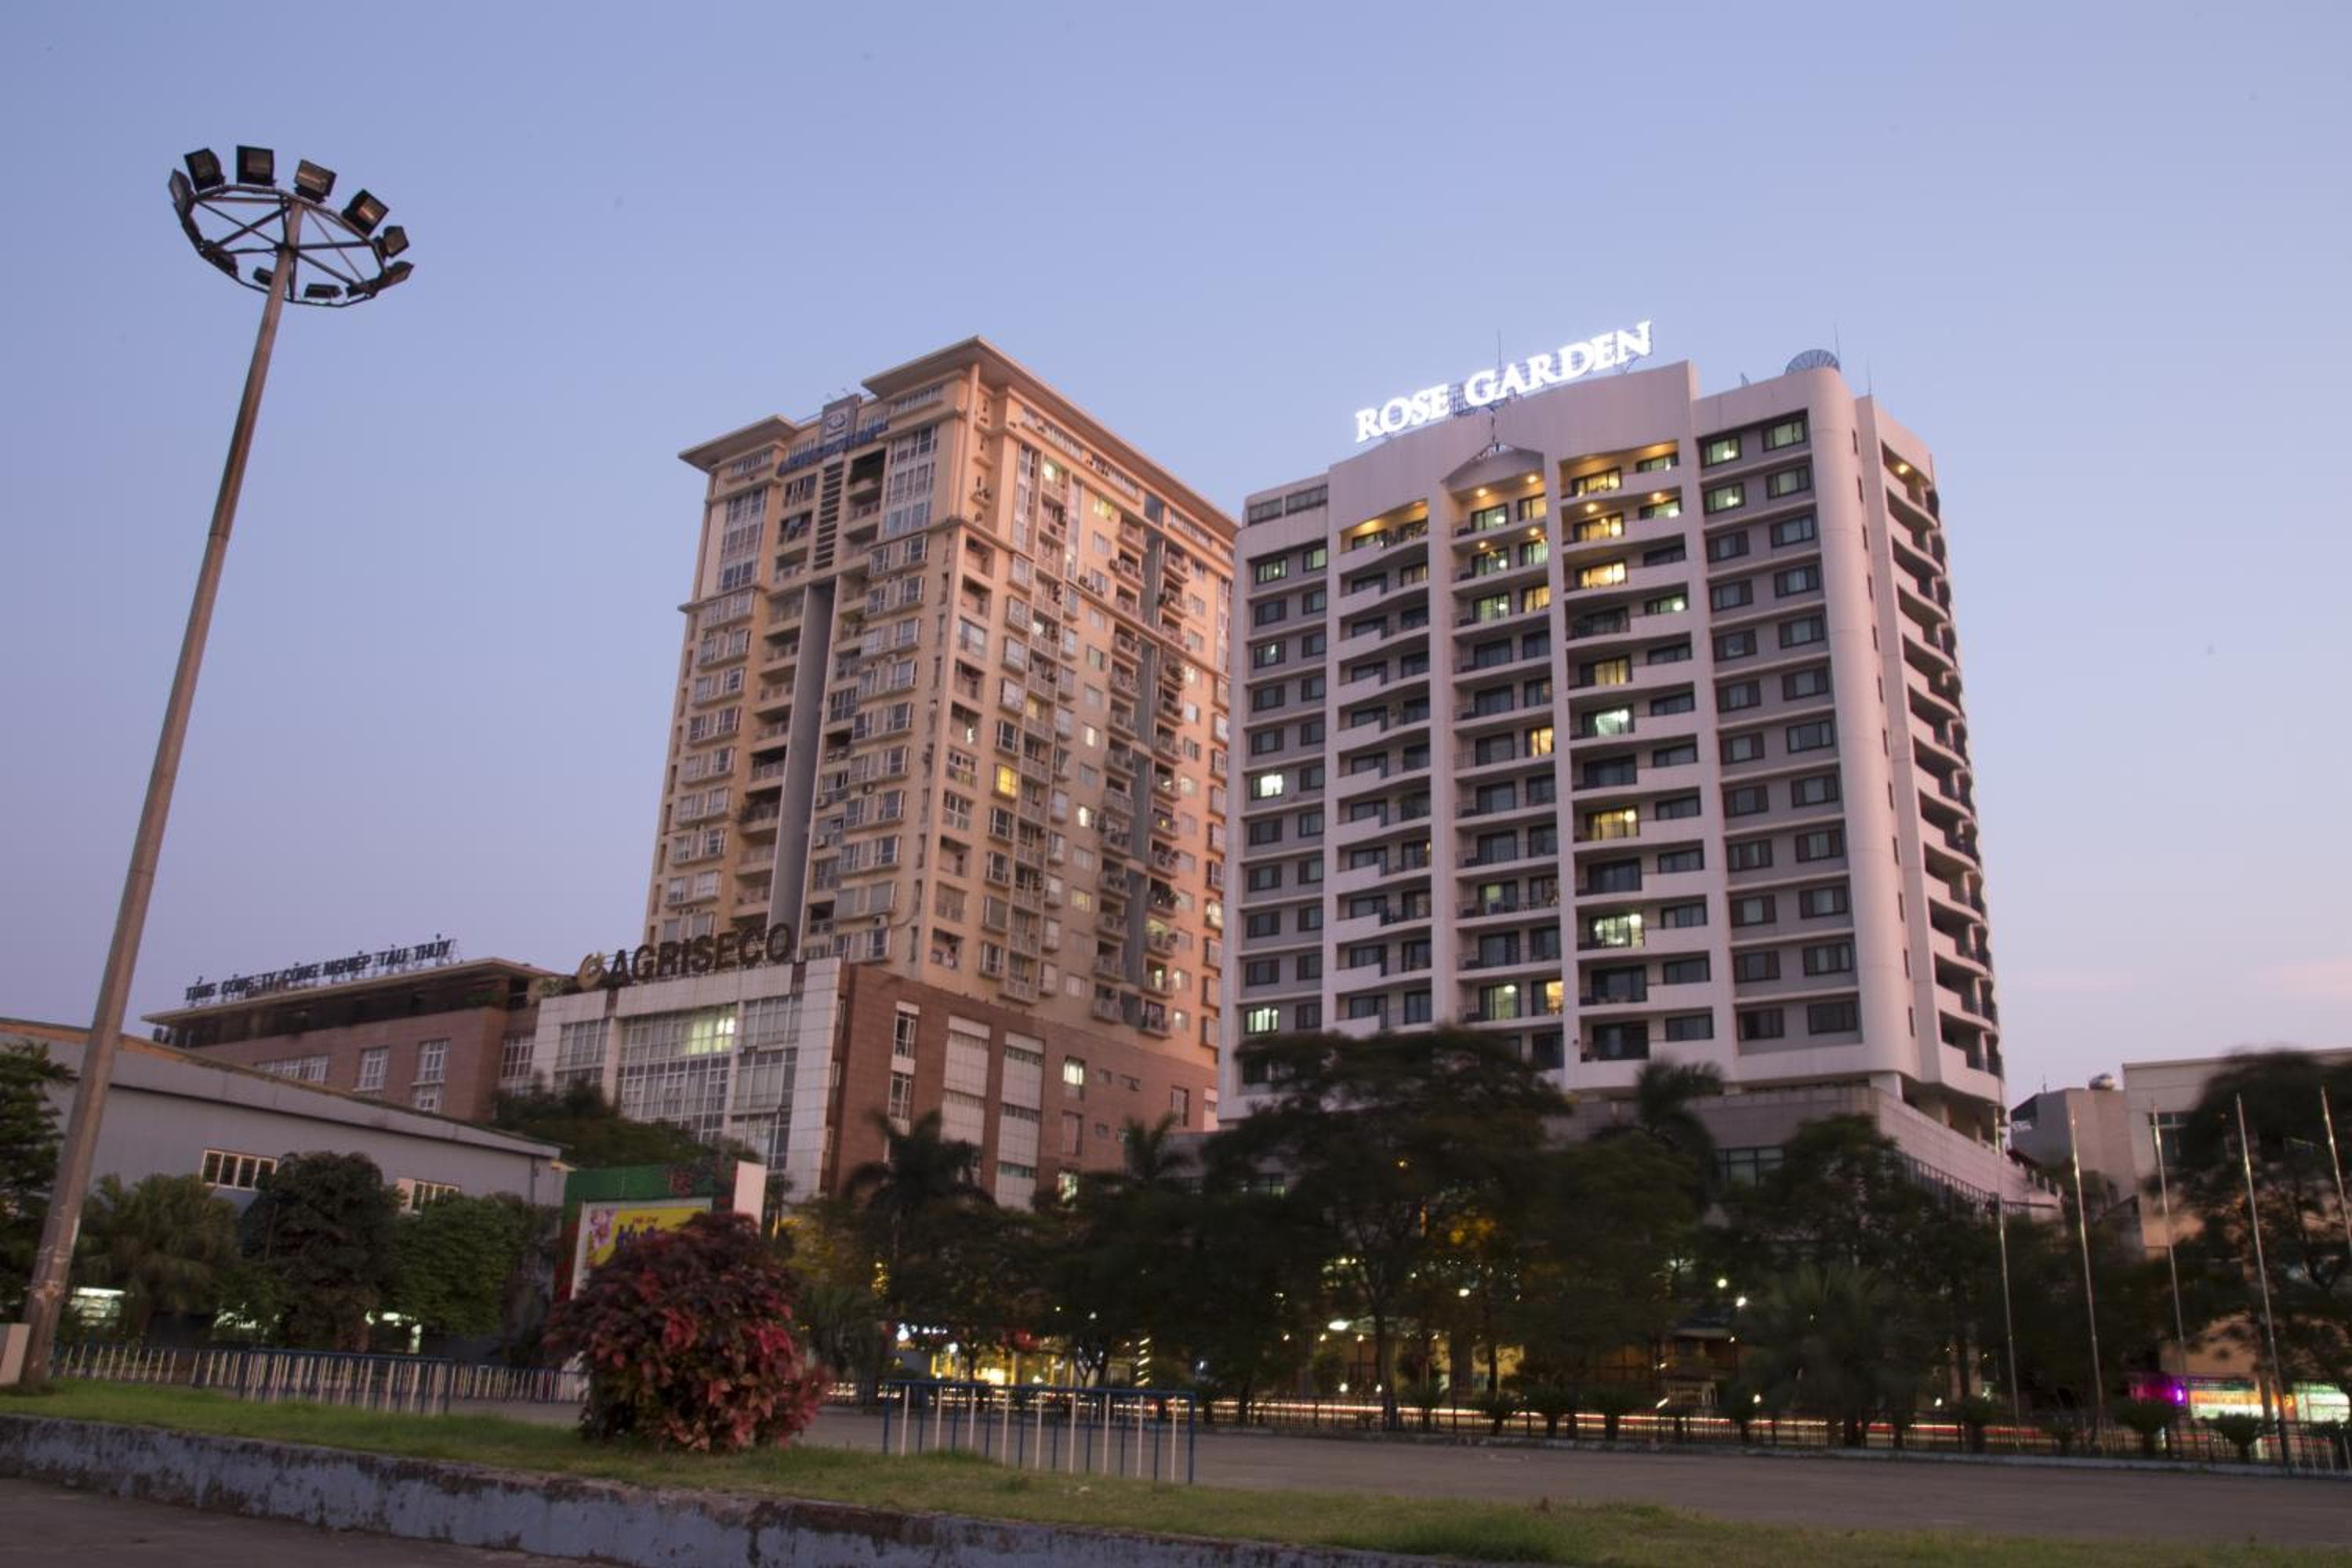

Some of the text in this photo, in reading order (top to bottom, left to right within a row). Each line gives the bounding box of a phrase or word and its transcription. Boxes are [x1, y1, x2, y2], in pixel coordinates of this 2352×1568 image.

[1355, 321, 1652, 444] ROSE GARDEN
[608, 923, 792, 982] AGRISECO
